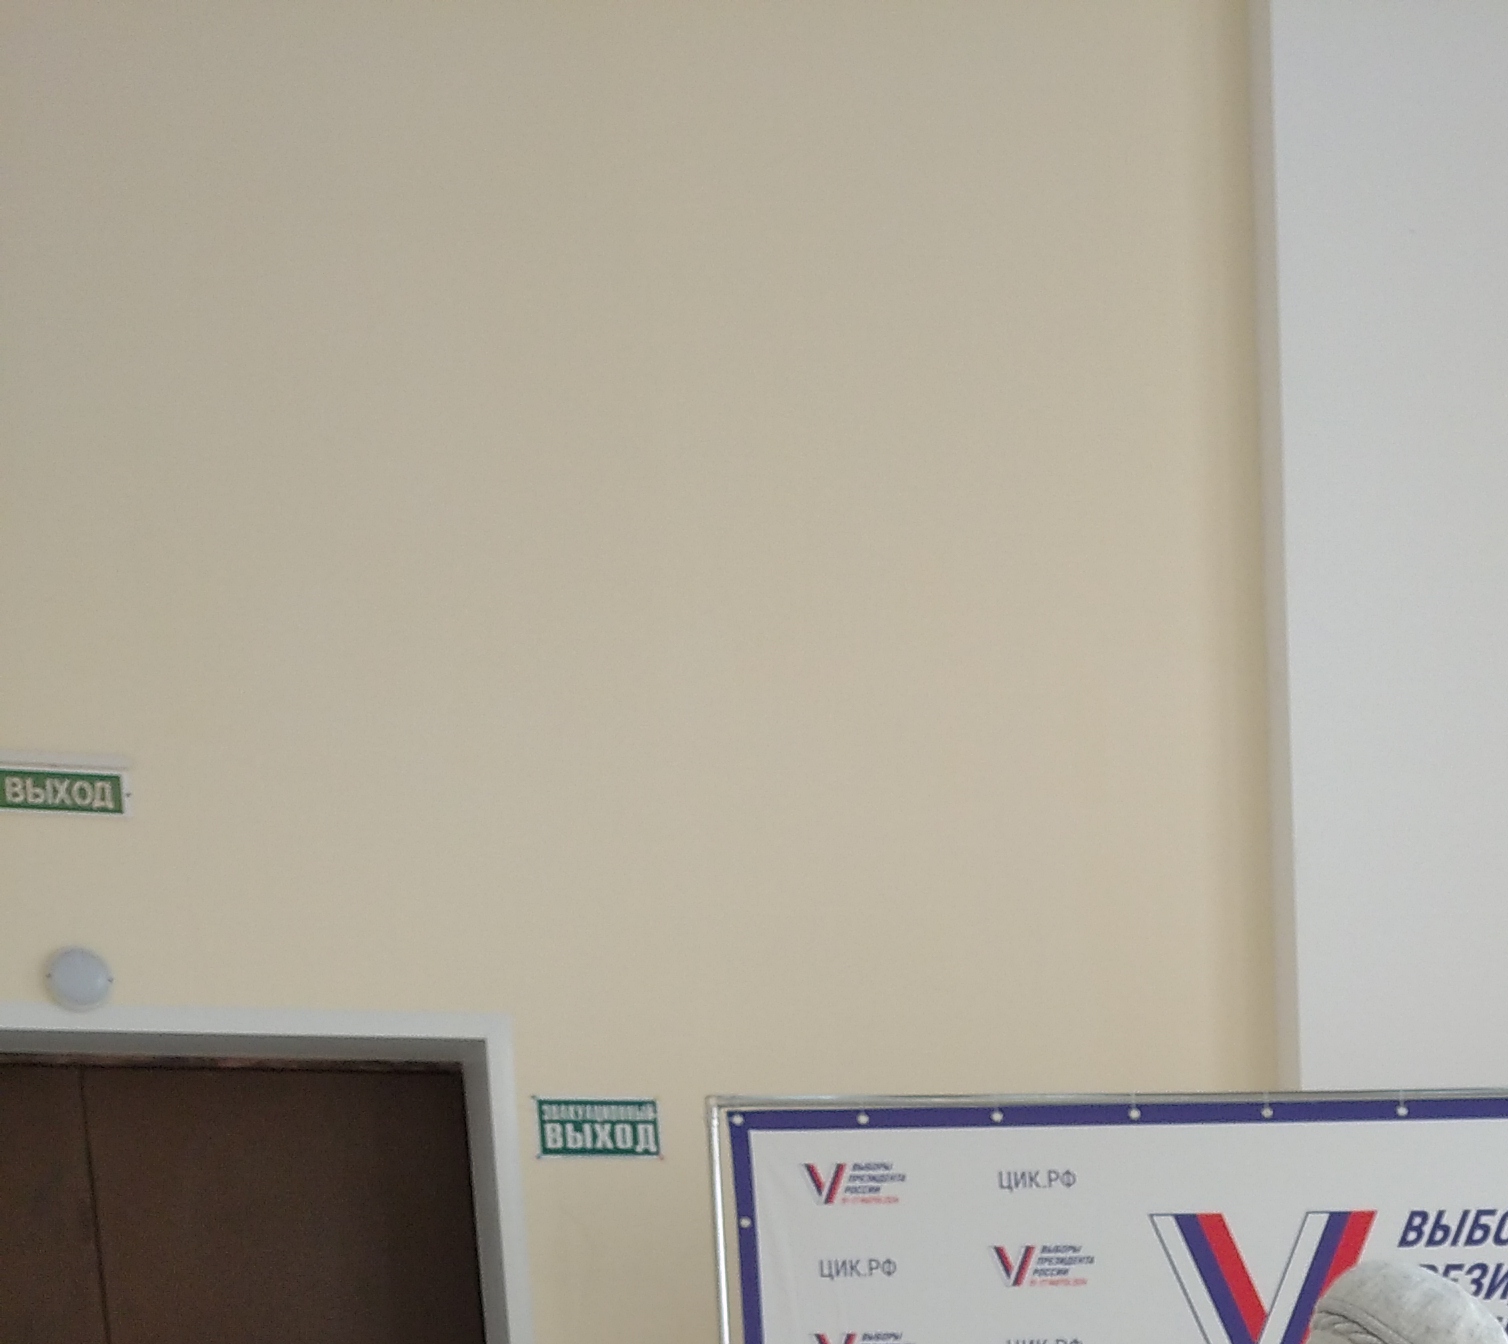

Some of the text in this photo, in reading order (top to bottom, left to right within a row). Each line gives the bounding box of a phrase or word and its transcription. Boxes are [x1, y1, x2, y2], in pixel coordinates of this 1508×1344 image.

[4, 776, 114, 809] ВЫХОД
[543, 1122, 657, 1152] ВЫХОД
[997, 1169, 1077, 1193] ЦИК.РФ
[818, 1258, 897, 1281] ЦИК.РФ
